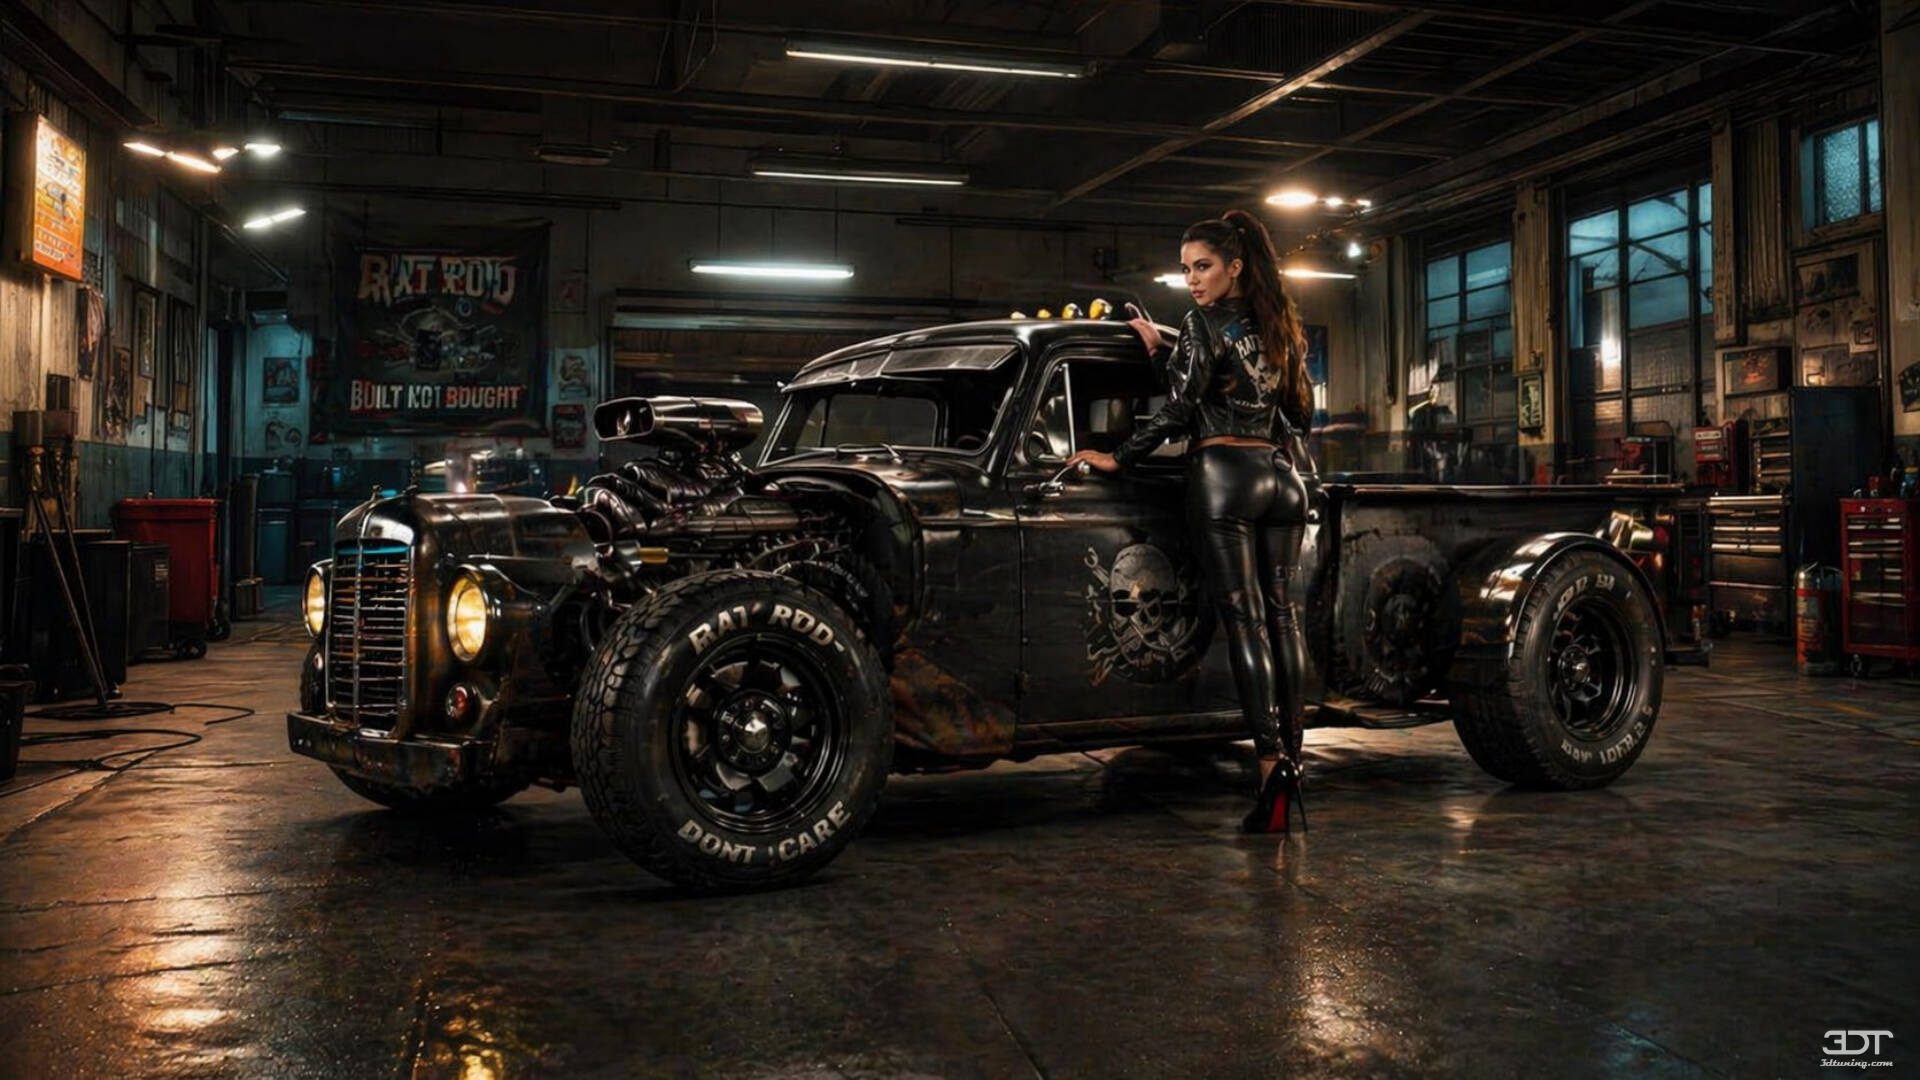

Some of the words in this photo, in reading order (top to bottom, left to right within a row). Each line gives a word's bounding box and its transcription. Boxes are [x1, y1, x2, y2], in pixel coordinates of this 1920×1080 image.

[350, 379, 403, 412] BUILT
[445, 384, 523, 410] BOUGHT
[688, 605, 749, 656] RAT
[677, 819, 757, 864] DONT
[778, 801, 852, 862] CARE
